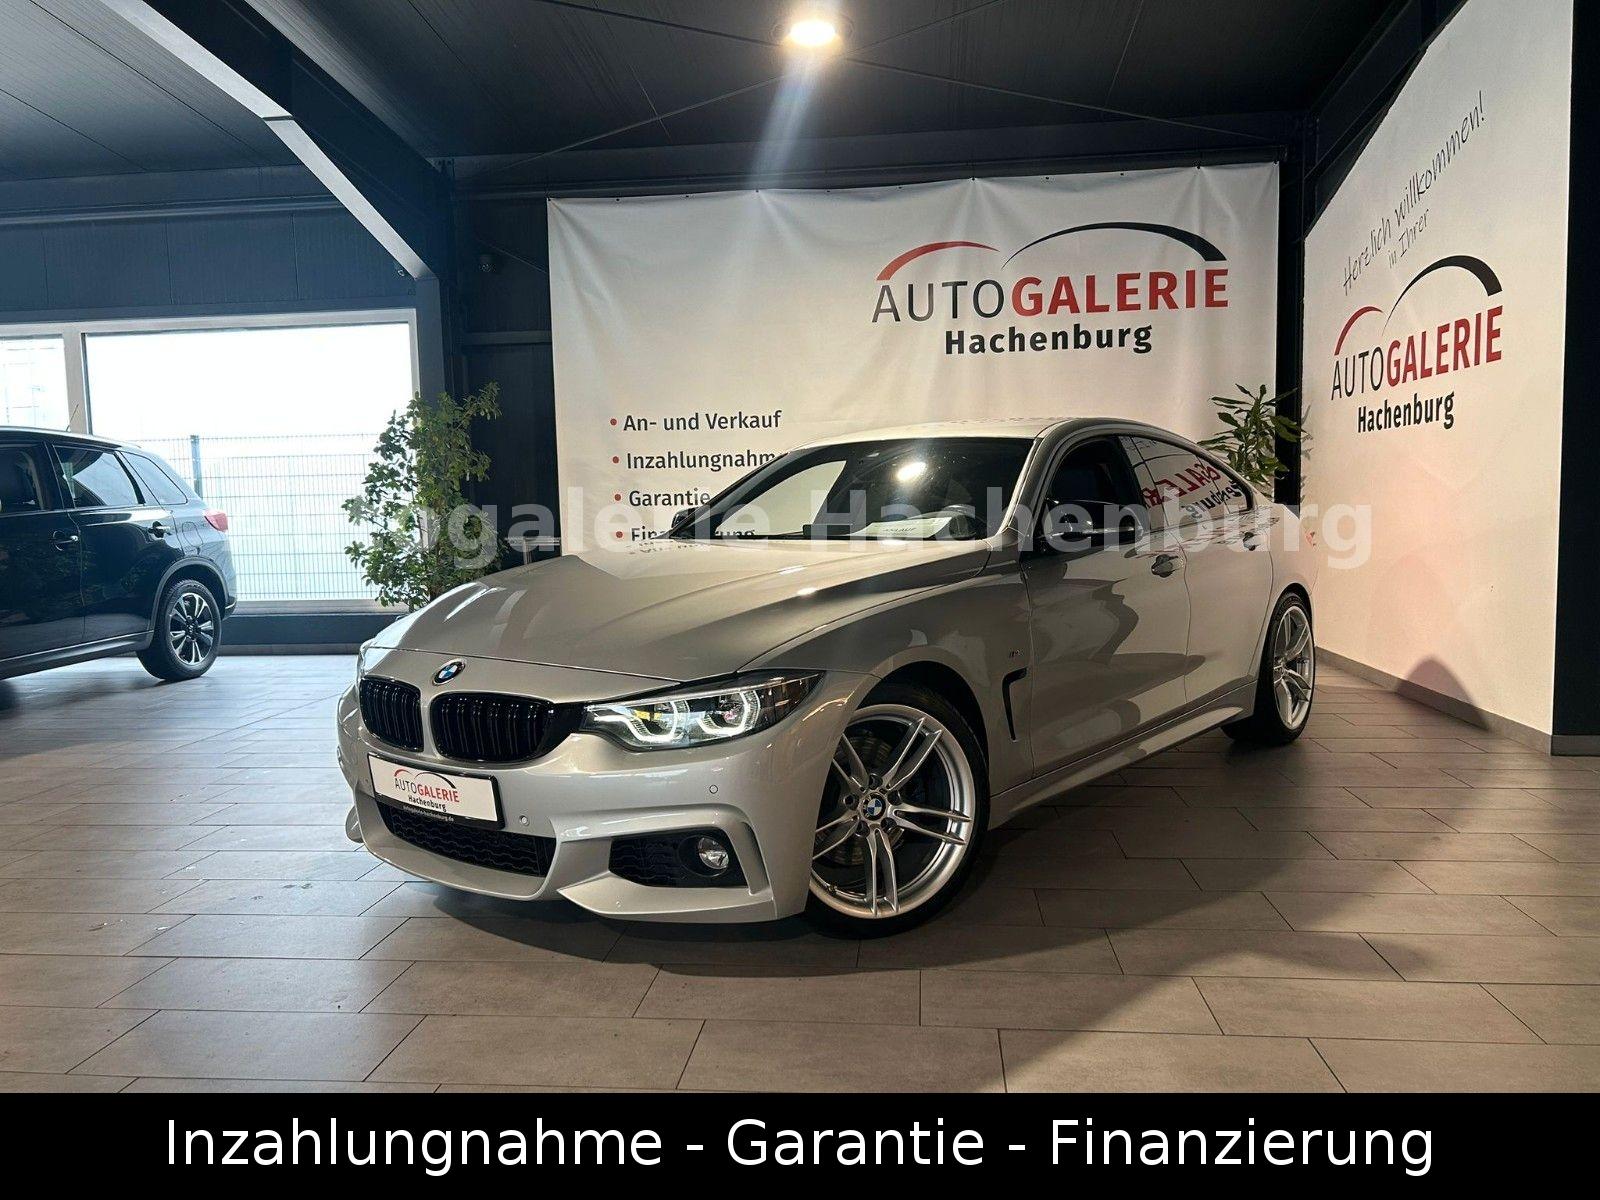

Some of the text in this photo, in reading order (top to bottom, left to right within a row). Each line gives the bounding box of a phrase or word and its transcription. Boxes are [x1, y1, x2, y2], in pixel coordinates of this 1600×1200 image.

[1394, 90, 1486, 227] willkommen!
[871, 269, 1229, 324] AUTOGALERIE
[944, 324, 1153, 355] Hachenburg
[1331, 305, 1504, 401] AUTOGALERIE
[623, 410, 783, 431] An- und Verkauf
[1357, 391, 1455, 433] Hachenburg
[627, 449, 778, 472] Inzahlungnahm
[629, 487, 711, 507] Garantie
[393, 777, 461, 803] AUTOGALERIE
[407, 794, 448, 812] Hachenburg
